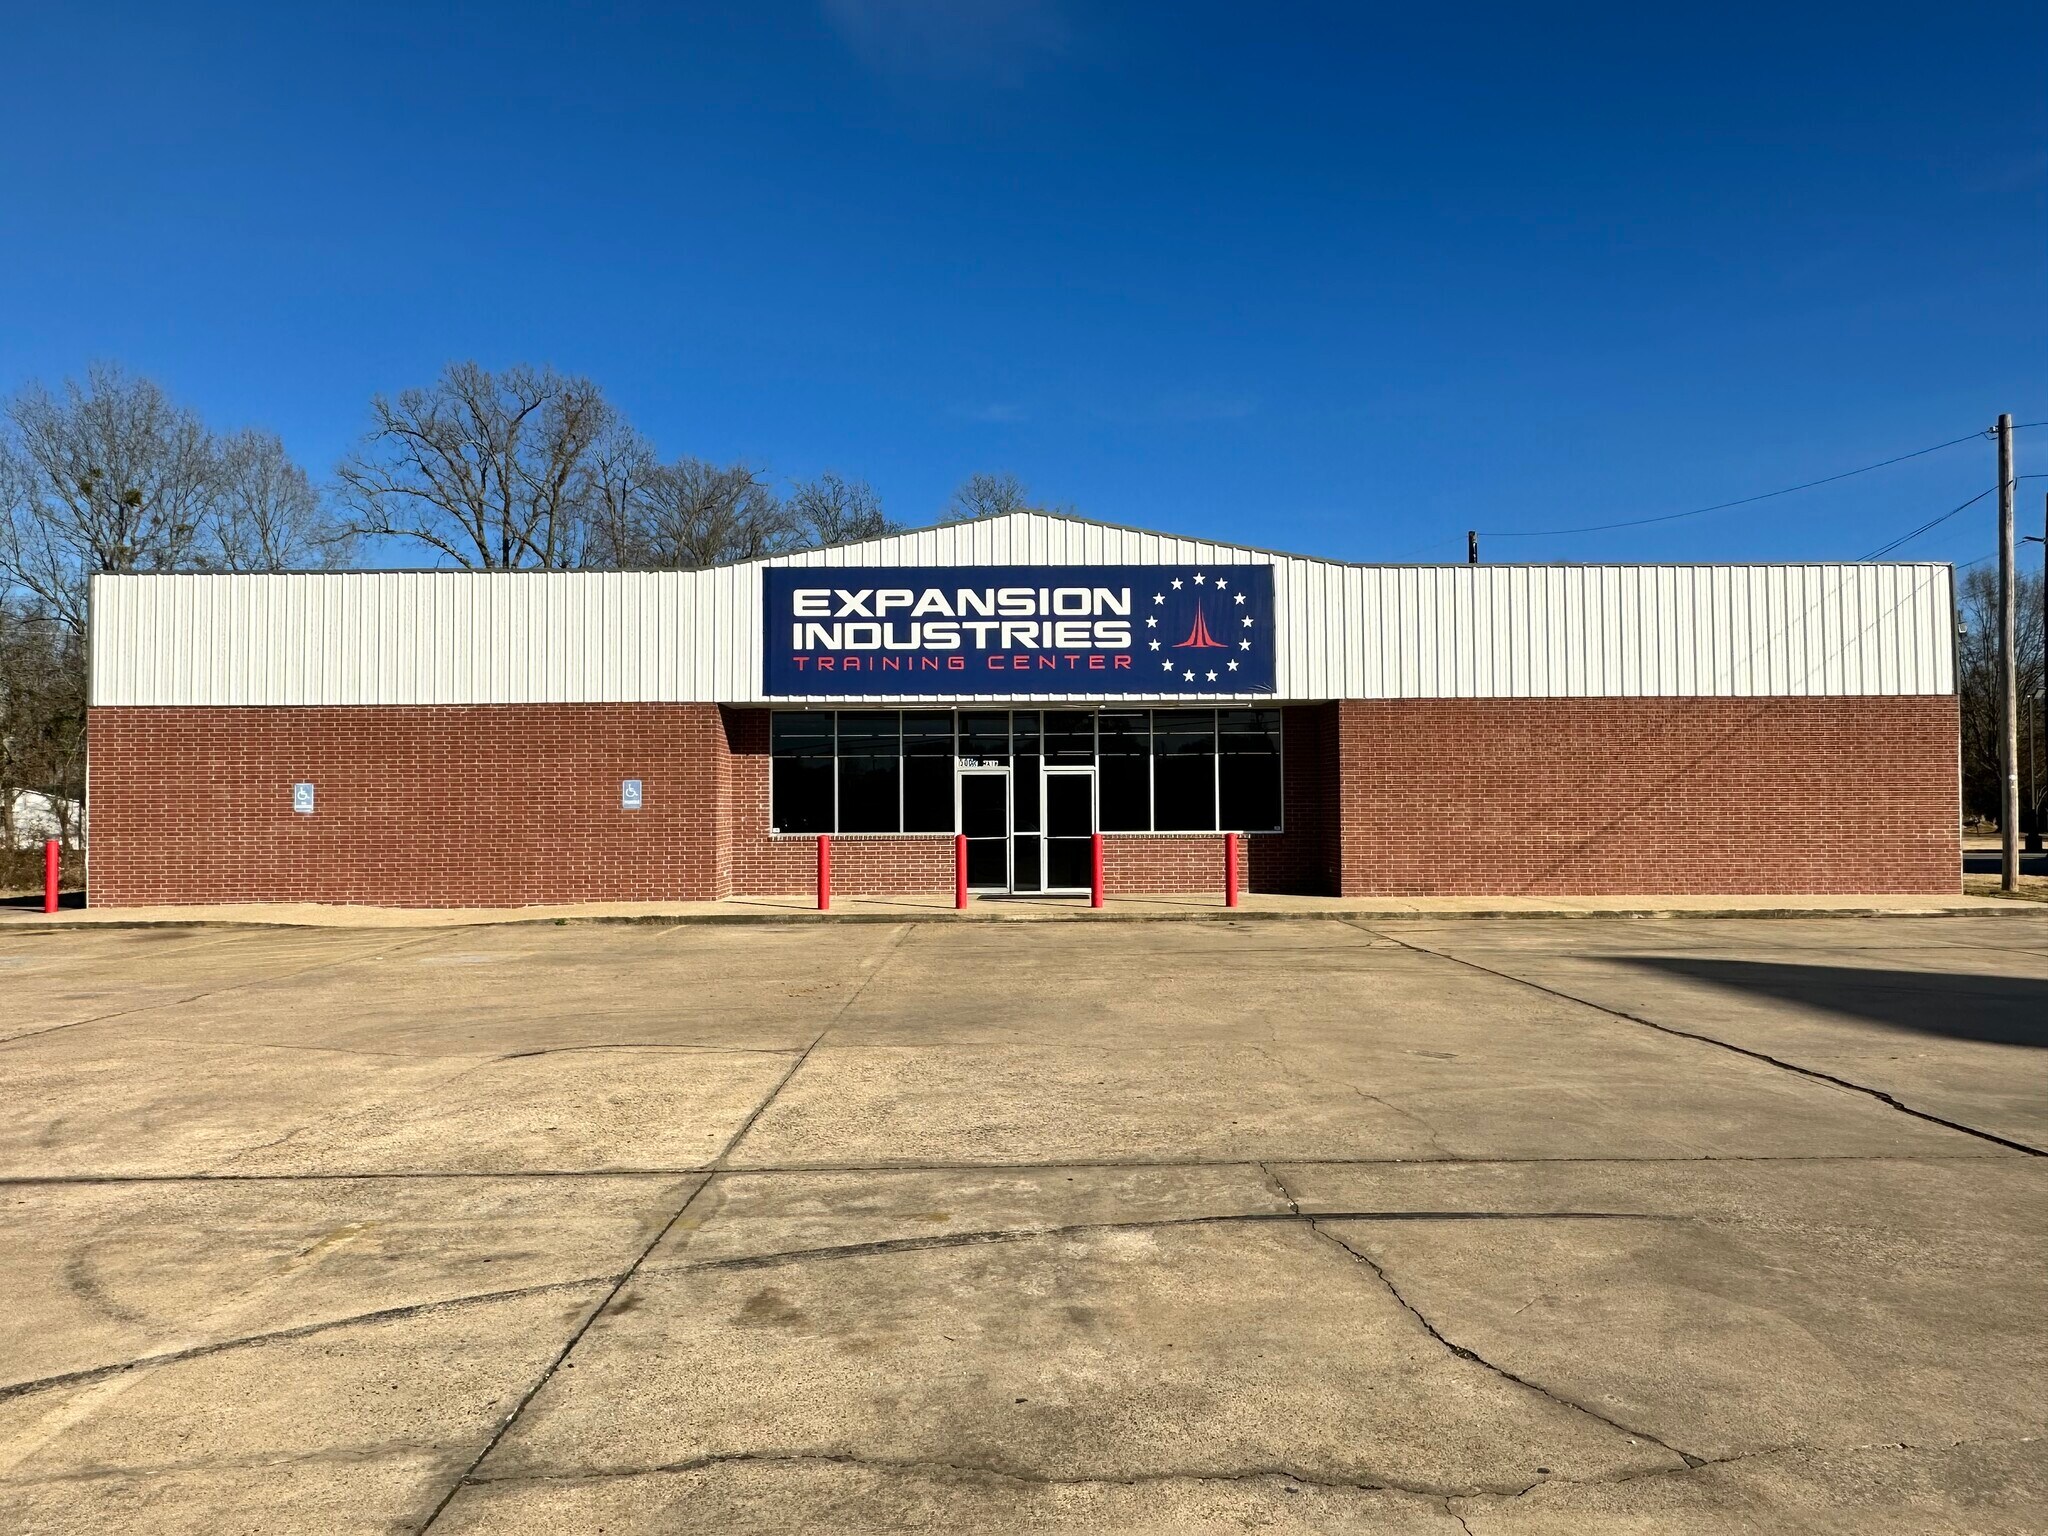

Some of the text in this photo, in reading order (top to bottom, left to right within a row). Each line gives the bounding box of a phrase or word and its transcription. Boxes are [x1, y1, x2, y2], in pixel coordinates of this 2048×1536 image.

[793, 588, 1131, 617] EXPANSION
[793, 621, 1131, 650] INDUSTRIES
[793, 655, 1131, 671] TRAINING CENTER
